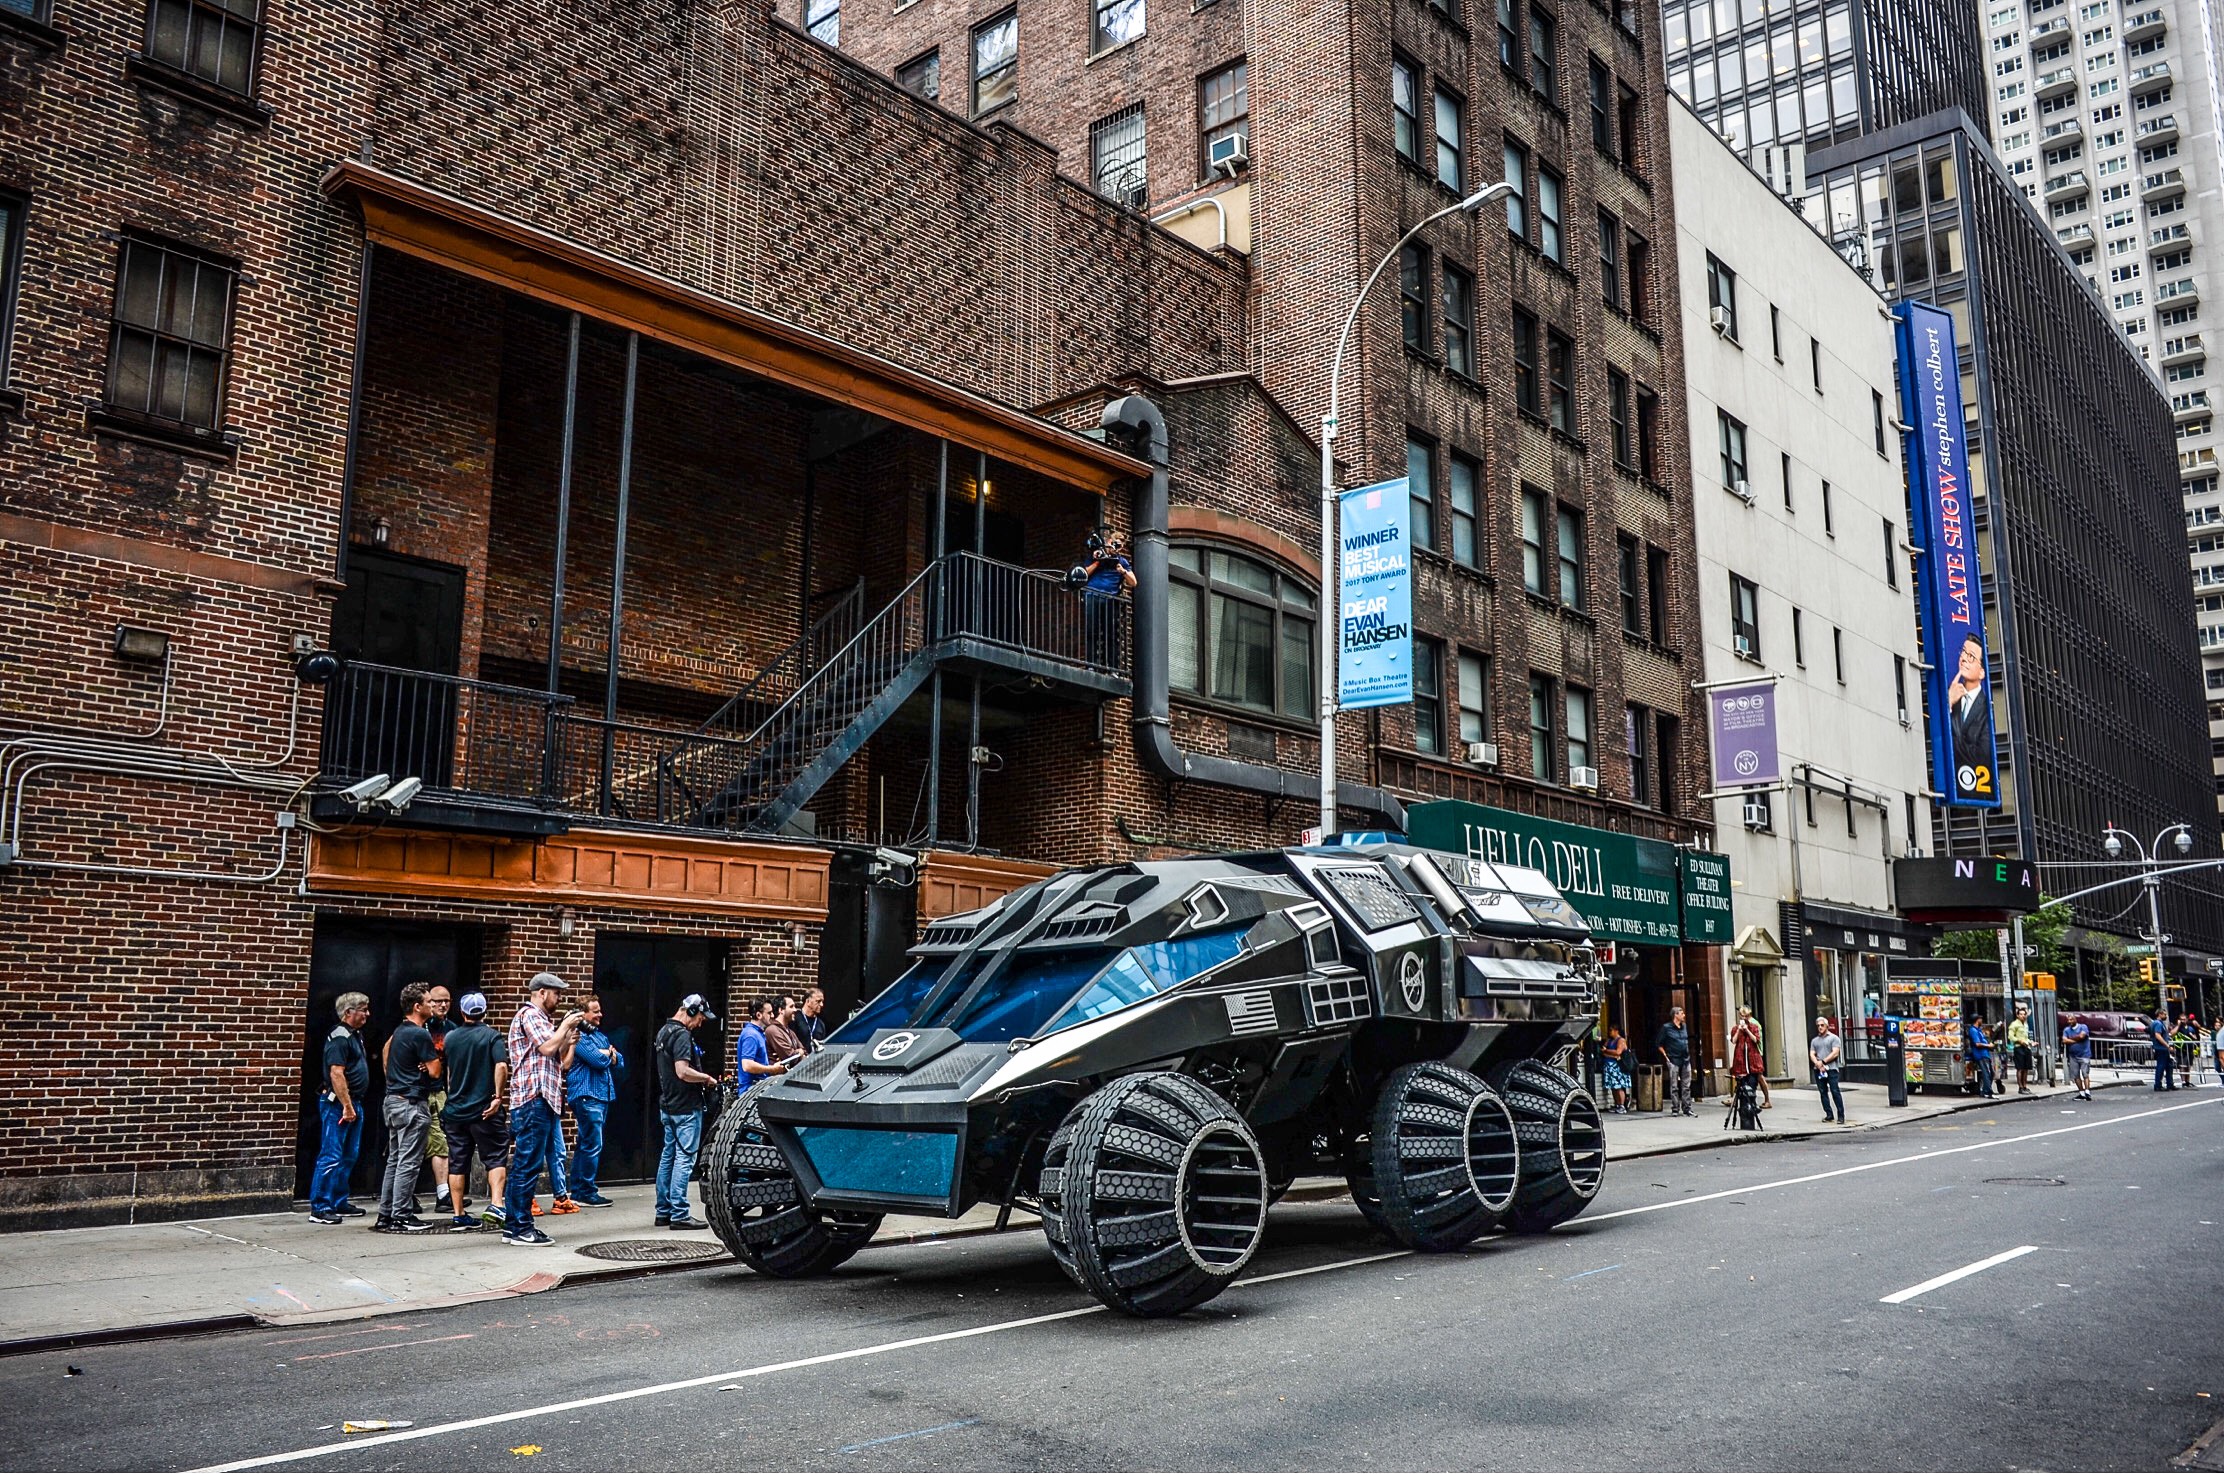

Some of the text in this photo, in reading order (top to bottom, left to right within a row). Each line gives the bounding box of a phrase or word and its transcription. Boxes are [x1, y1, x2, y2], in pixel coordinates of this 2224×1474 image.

[1926, 327, 1970, 625] LATE SHOW stephen colbert
[1345, 528, 1398, 550] WINNER
[1345, 546, 1380, 565] BEST
[1345, 554, 1406, 579] MUSICAL
[1346, 569, 1406, 587] 2017 TONY AWARD
[1344, 596, 1388, 618] DEAR
[1345, 612, 1384, 632] EVAN
[1344, 623, 1407, 647] HANSEN
[1354, 644, 1382, 652] BROADWAY
[1383, 673, 1407, 681] Theatre
[1343, 681, 1408, 695] DearEvanHansen.com
[1739, 760, 1755, 770] NY
[1976, 765, 1991, 792] 2
[1464, 824, 1605, 896] HELLO DELI
[1690, 859, 1723, 876] ED SULLIVAN
[1696, 877, 1719, 892] THEATER
[1612, 884, 1669, 905] FREE DELIVERY
[1687, 893, 1729, 911] OFFICE BUILDING
[1587, 915, 1604, 931] SODA
[1609, 917, 1622, 932] HOT
[1623, 918, 1642, 934] DISHES
[1595, 948, 1613, 962] PEN
